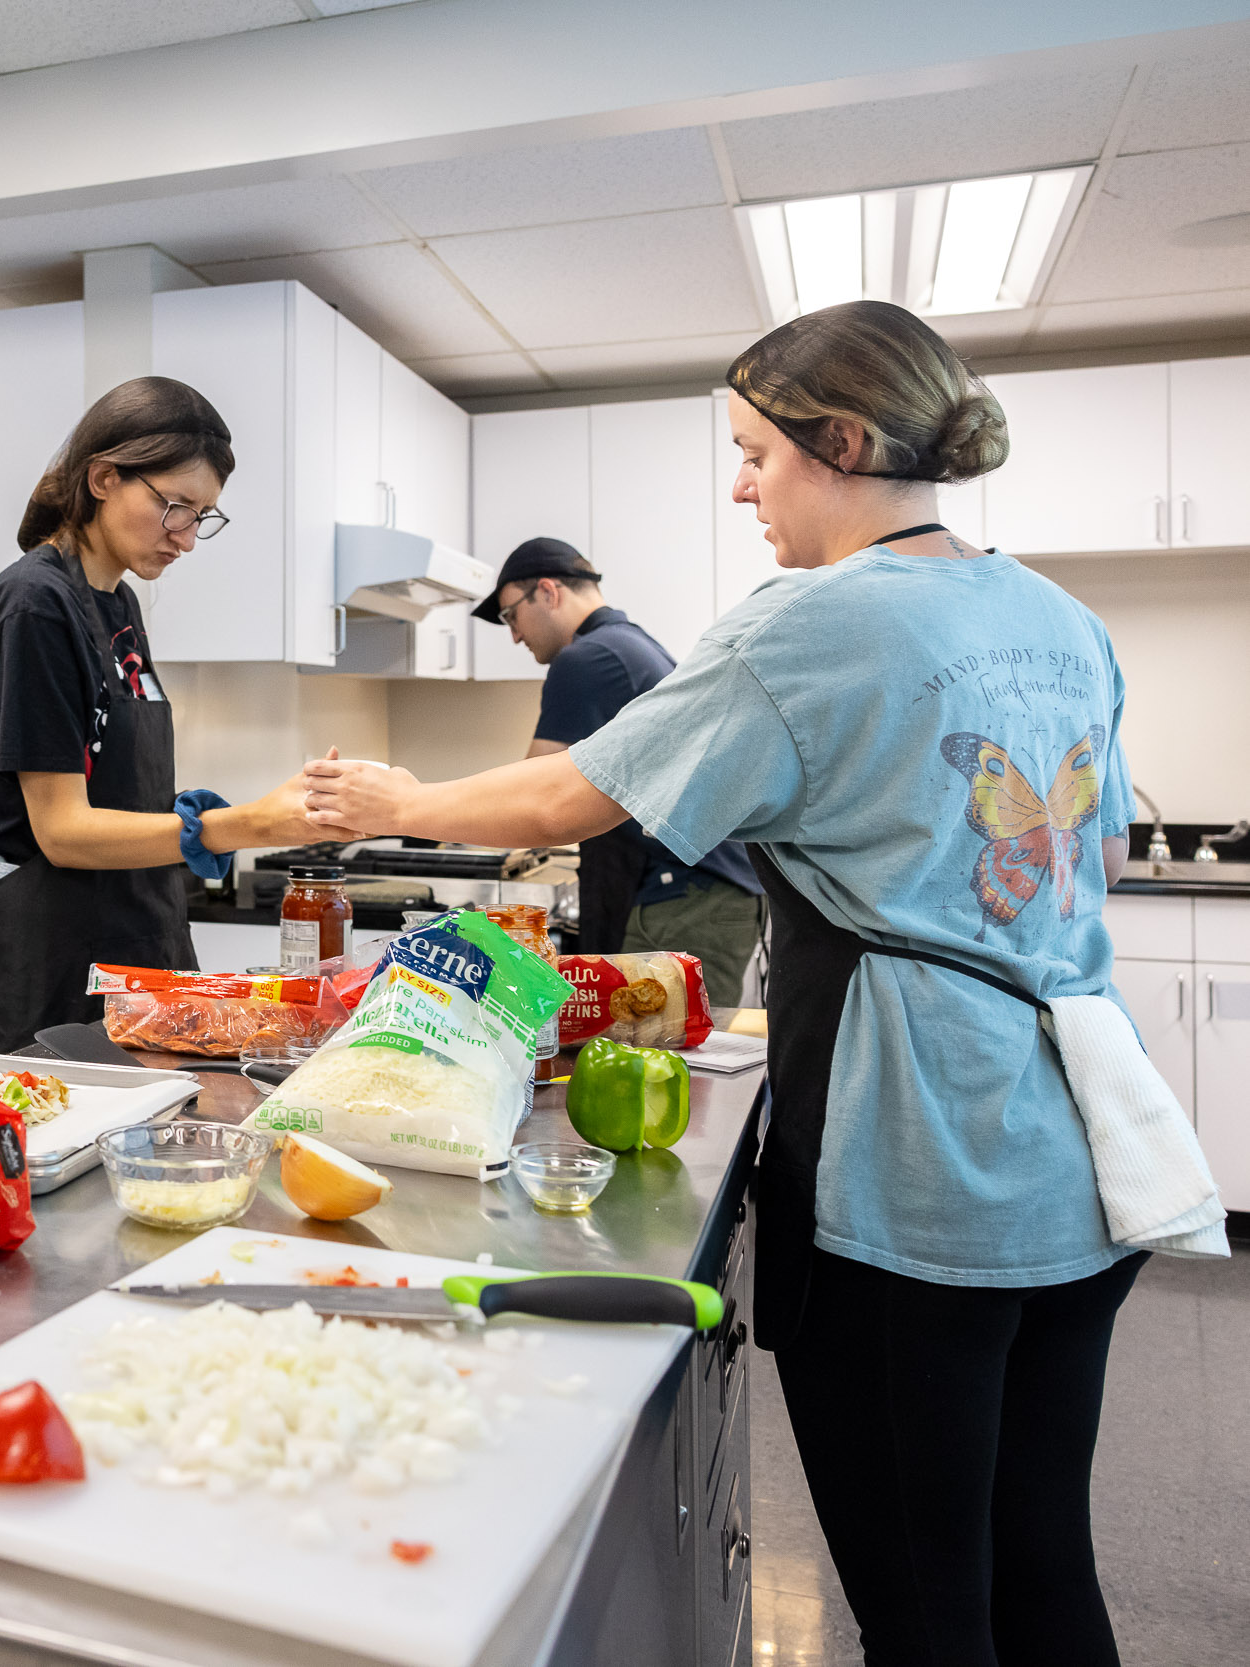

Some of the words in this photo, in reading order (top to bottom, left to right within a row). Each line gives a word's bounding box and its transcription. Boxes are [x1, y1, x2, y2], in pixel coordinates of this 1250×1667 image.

[922, 655, 980, 697] MIND
[989, 648, 1034, 665] BODY
[1049, 650, 1104, 686] SPIRI
[975, 657, 1091, 711] Transformation
[416, 980, 447, 1004] SIZE
[415, 996, 488, 1048] part-skim
[357, 1034, 411, 1048] SHREDDED
[390, 1132, 405, 1144] NET
[406, 1134, 417, 1145] WT
[428, 1138, 438, 1150] OZ
